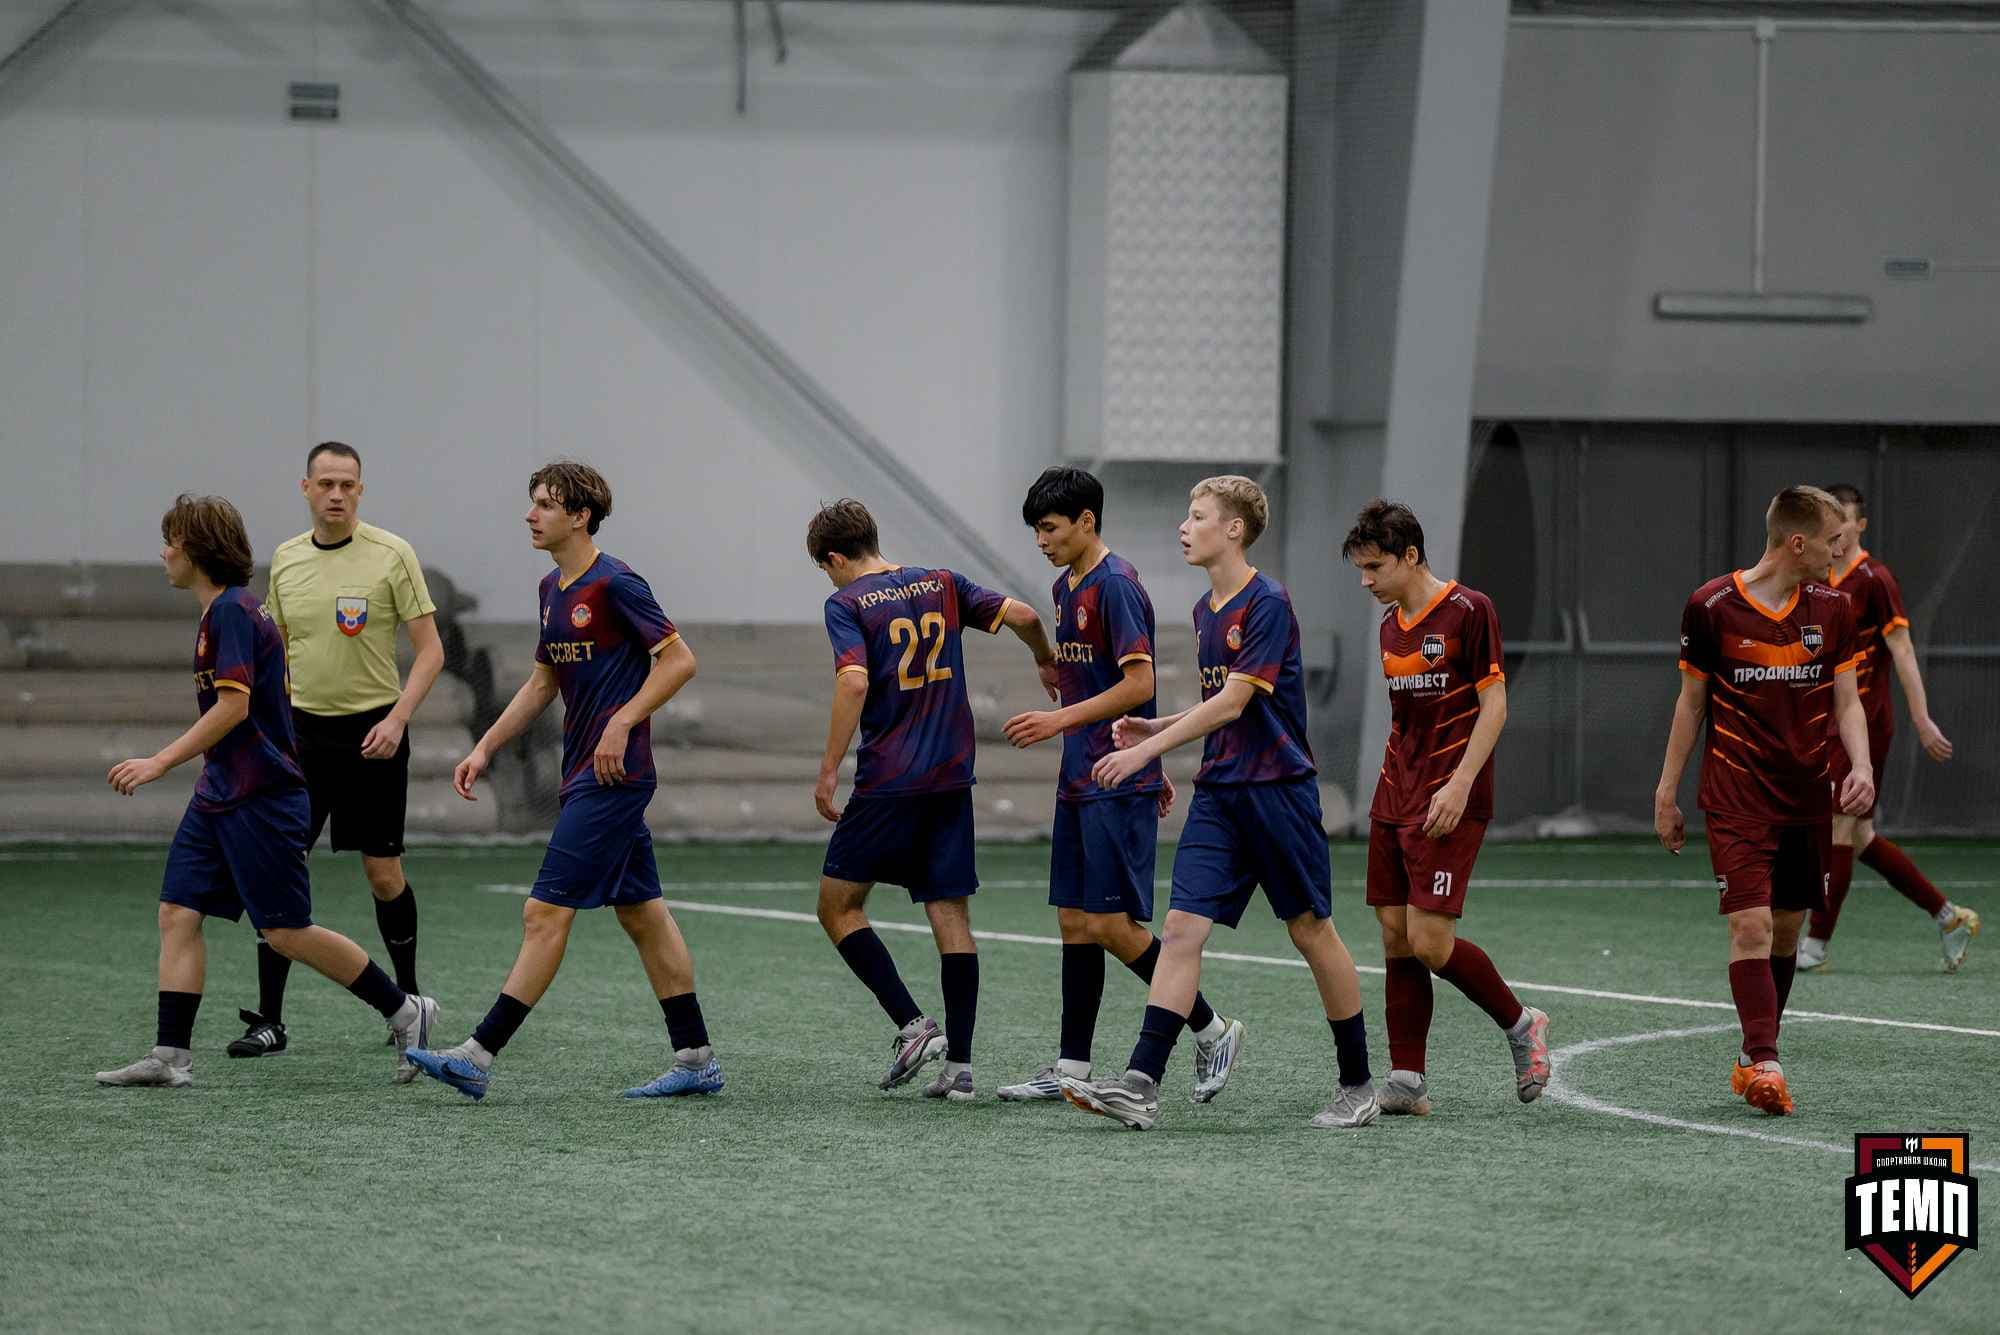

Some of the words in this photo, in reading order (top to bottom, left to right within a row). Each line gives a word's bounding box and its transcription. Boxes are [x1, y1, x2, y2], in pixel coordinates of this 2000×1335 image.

[888, 611, 953, 691] 22
[1424, 643, 1443, 656] ТЕМП
[1734, 664, 1823, 684] ПРОДИНВЕСТ
[1433, 871, 1453, 897] 21
